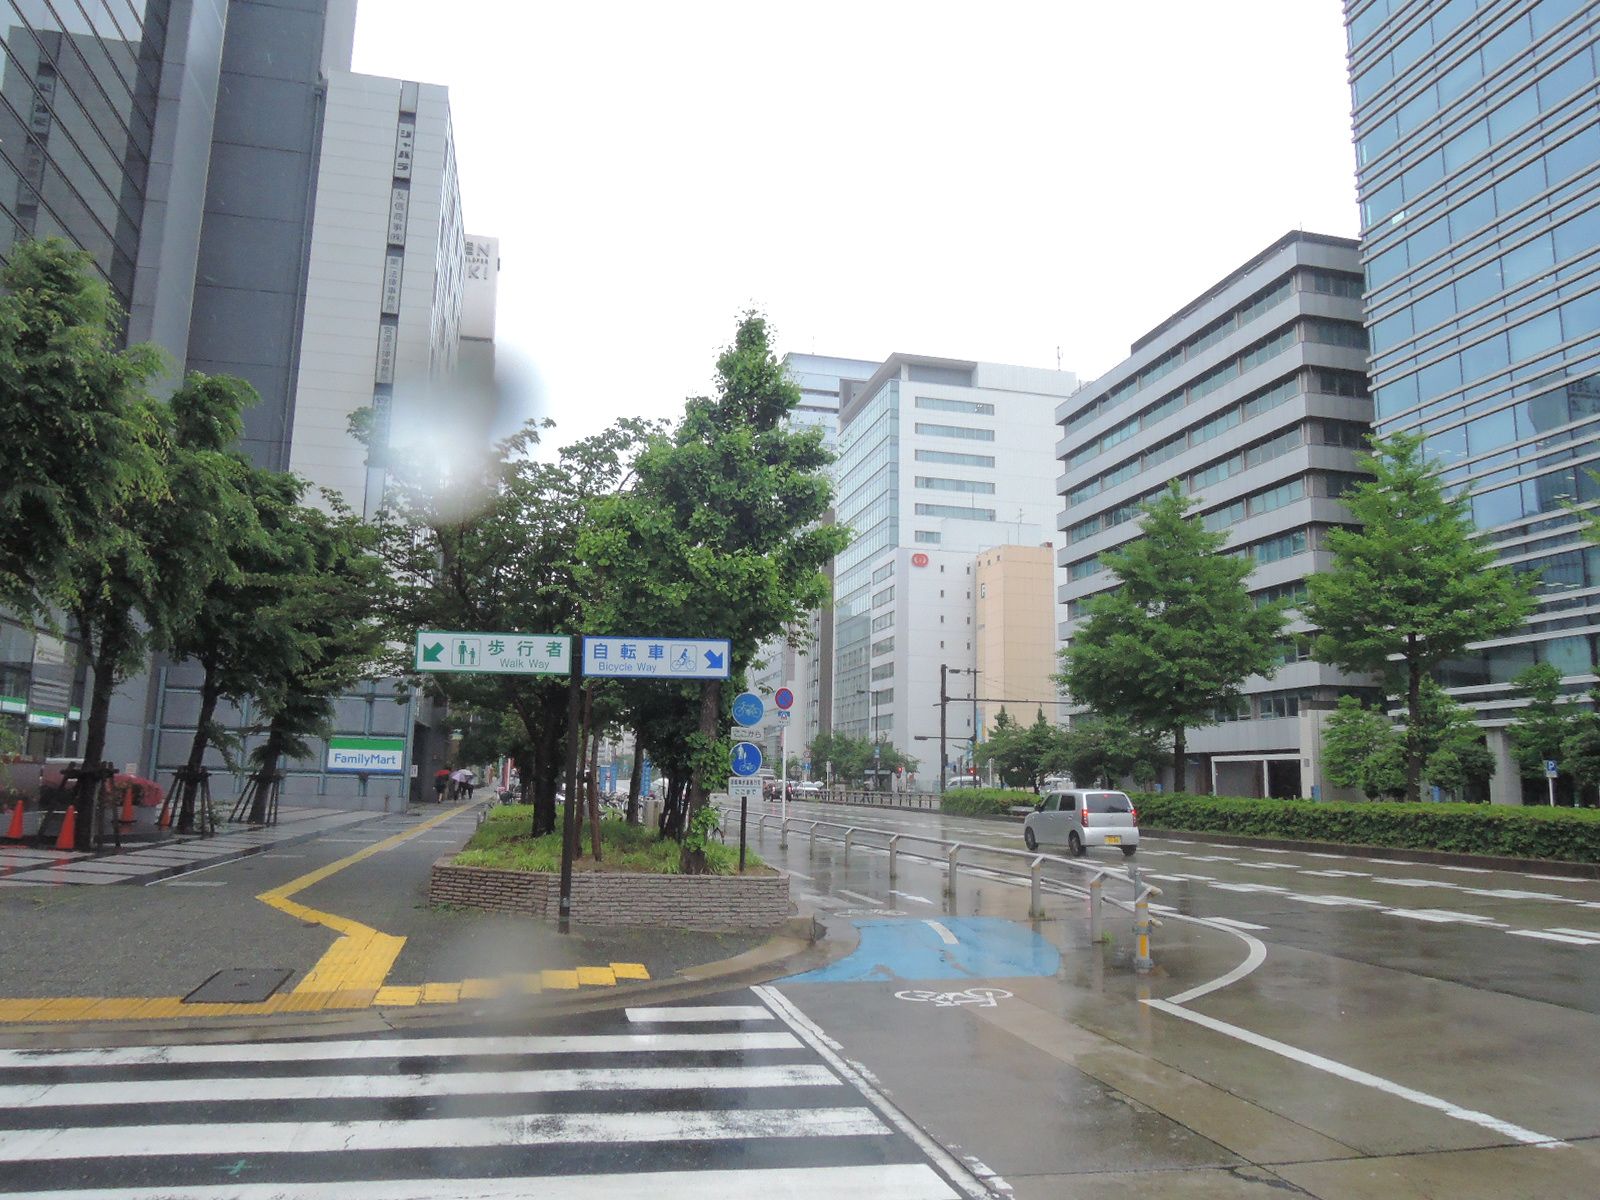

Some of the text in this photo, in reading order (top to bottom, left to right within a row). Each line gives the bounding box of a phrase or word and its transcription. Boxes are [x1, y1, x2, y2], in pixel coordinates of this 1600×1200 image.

[488, 640, 563, 658] 歩行者
[594, 643, 664, 660] 自転車
[500, 658, 551, 671] Walk Way
[598, 661, 657, 674] Bicycle Way
[334, 753, 397, 767] FamilyMart
